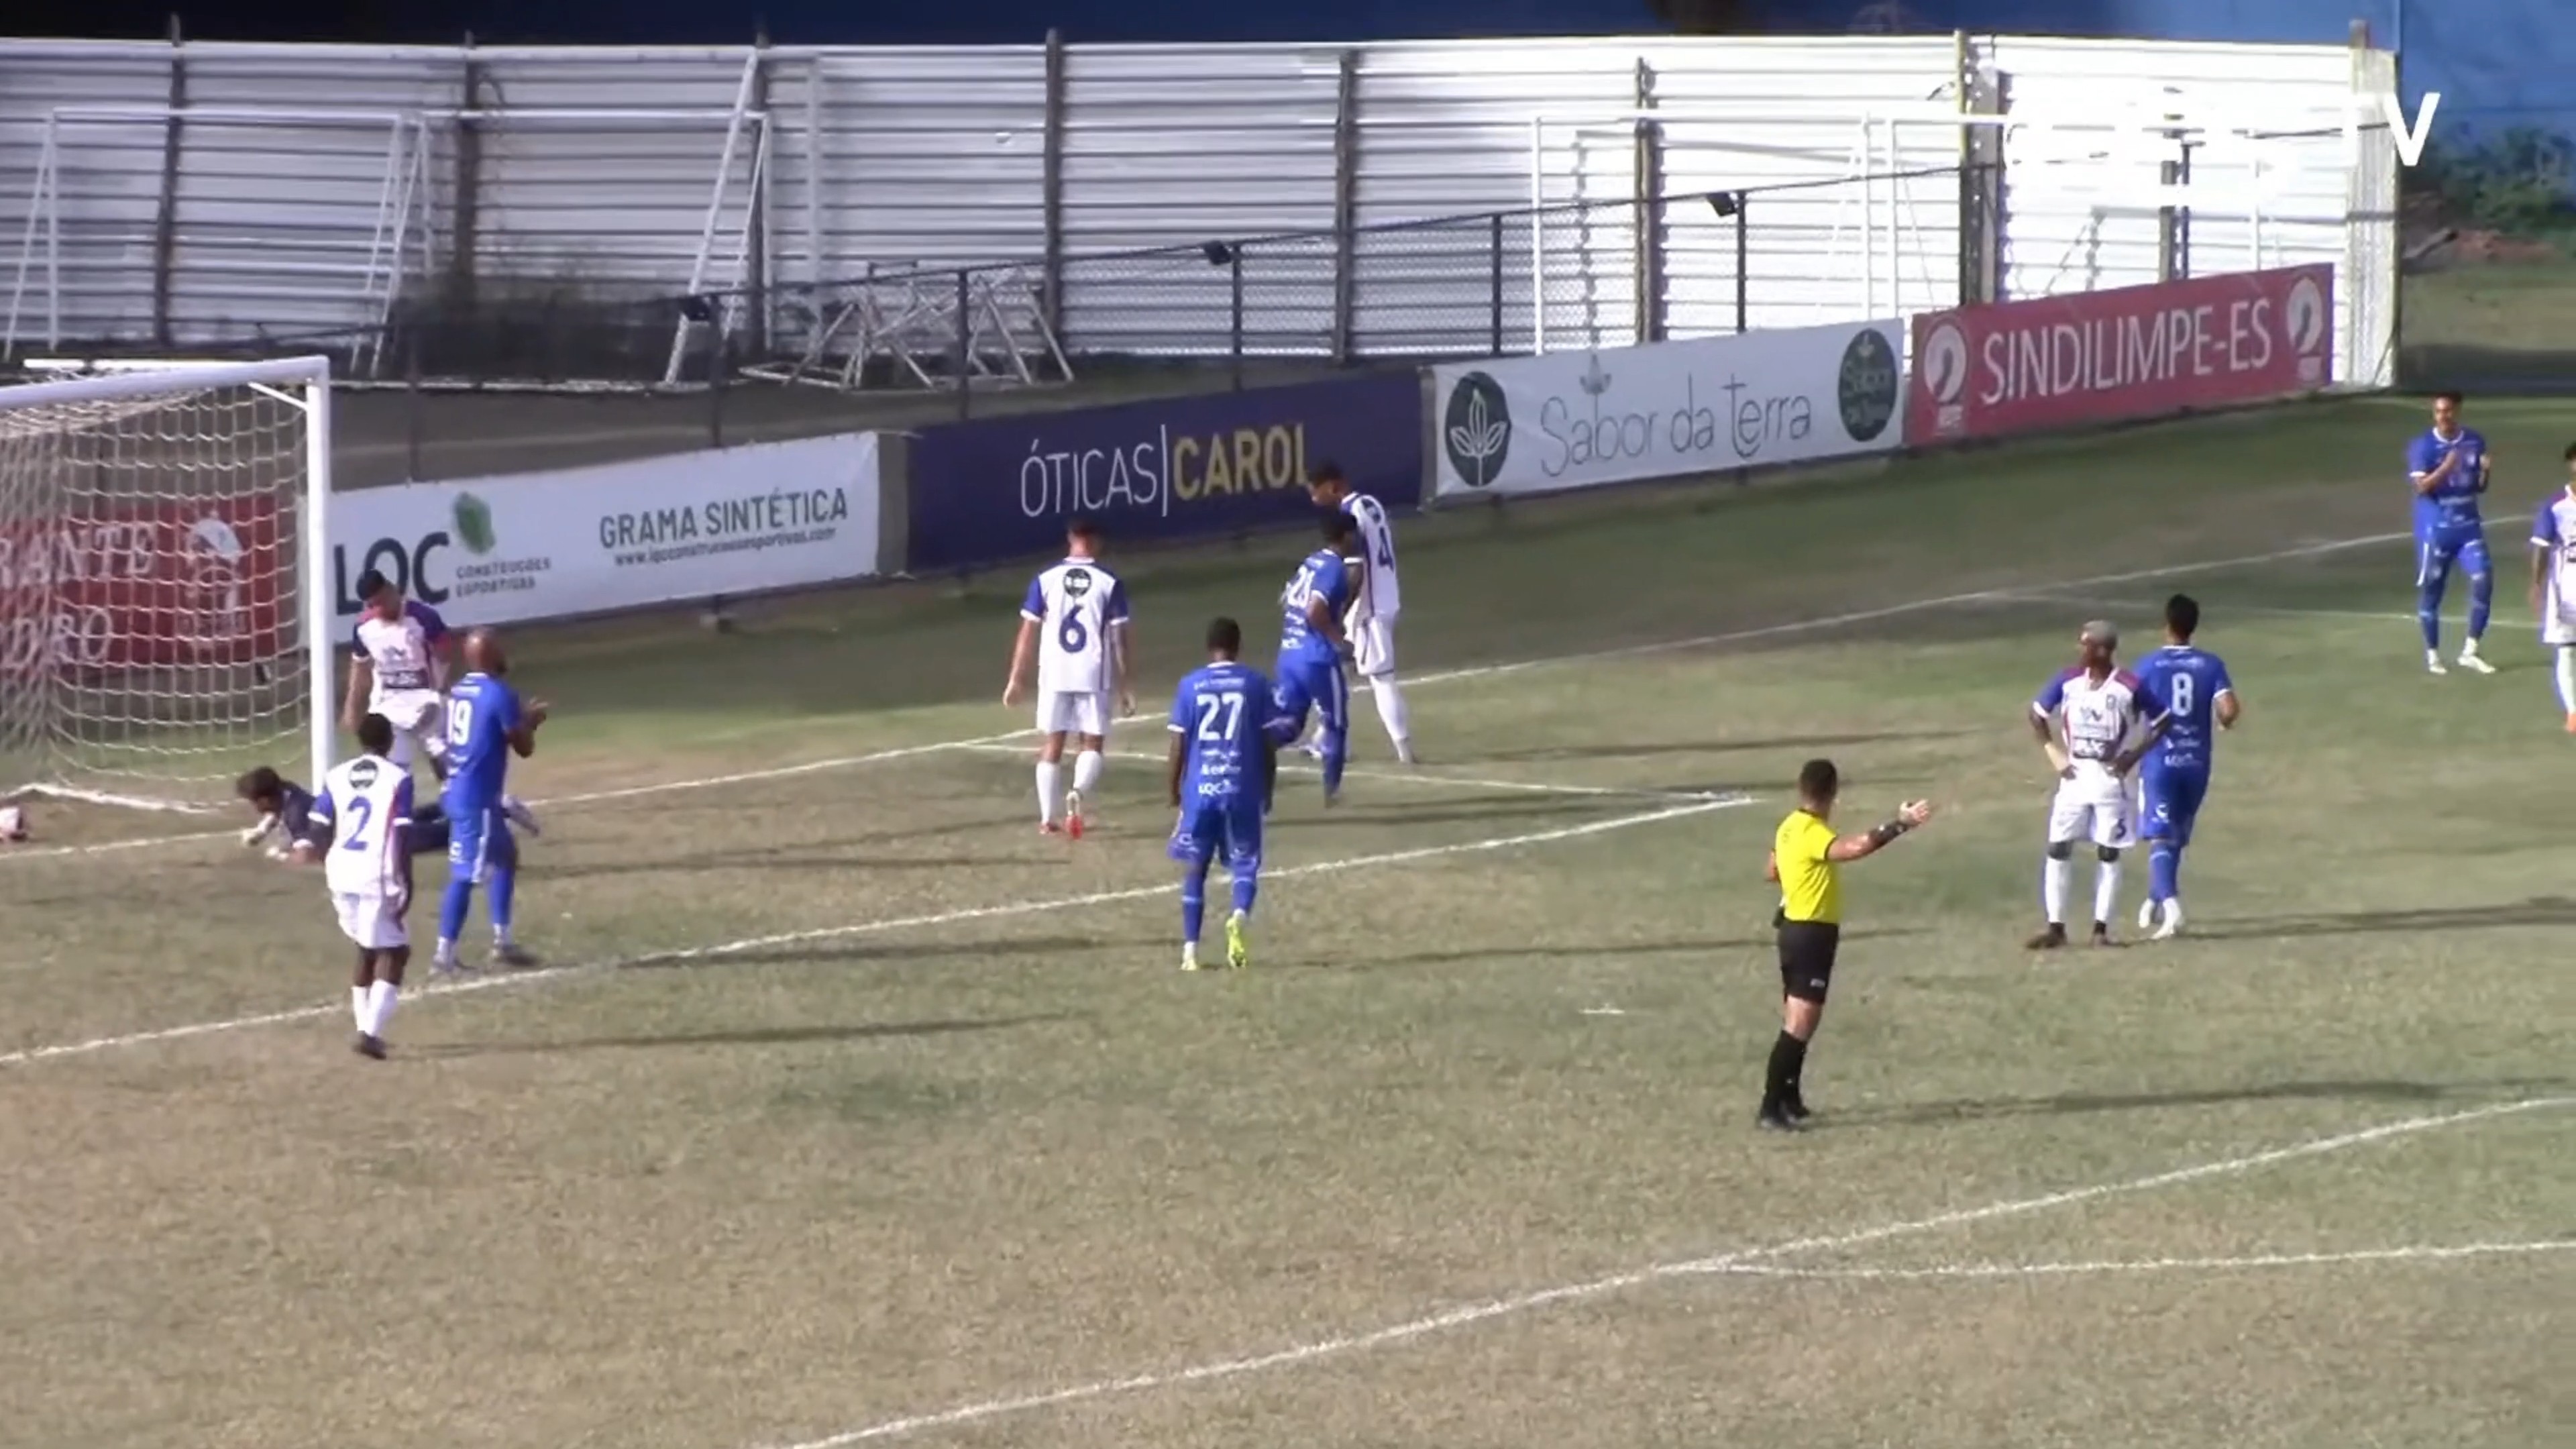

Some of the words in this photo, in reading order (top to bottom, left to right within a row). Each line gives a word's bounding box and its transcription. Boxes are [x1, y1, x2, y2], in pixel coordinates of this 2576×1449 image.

[1981, 297, 2272, 405] SINDILIMPE-ES
[1541, 396, 1659, 478] Sabor
[1670, 372, 1715, 453] da
[1020, 439, 1158, 517] ÓTICAS
[1173, 423, 1308, 500] CAROL
[599, 506, 698, 549] GRAMA
[706, 487, 848, 536] SINTÉTICA
[334, 530, 449, 616] LOC
[1378, 526, 1393, 572] 4
[1059, 604, 1087, 653] 6
[447, 699, 473, 745] 19
[1197, 691, 1244, 741] 27
[2171, 673, 2194, 716] 8
[343, 796, 372, 851] 2
